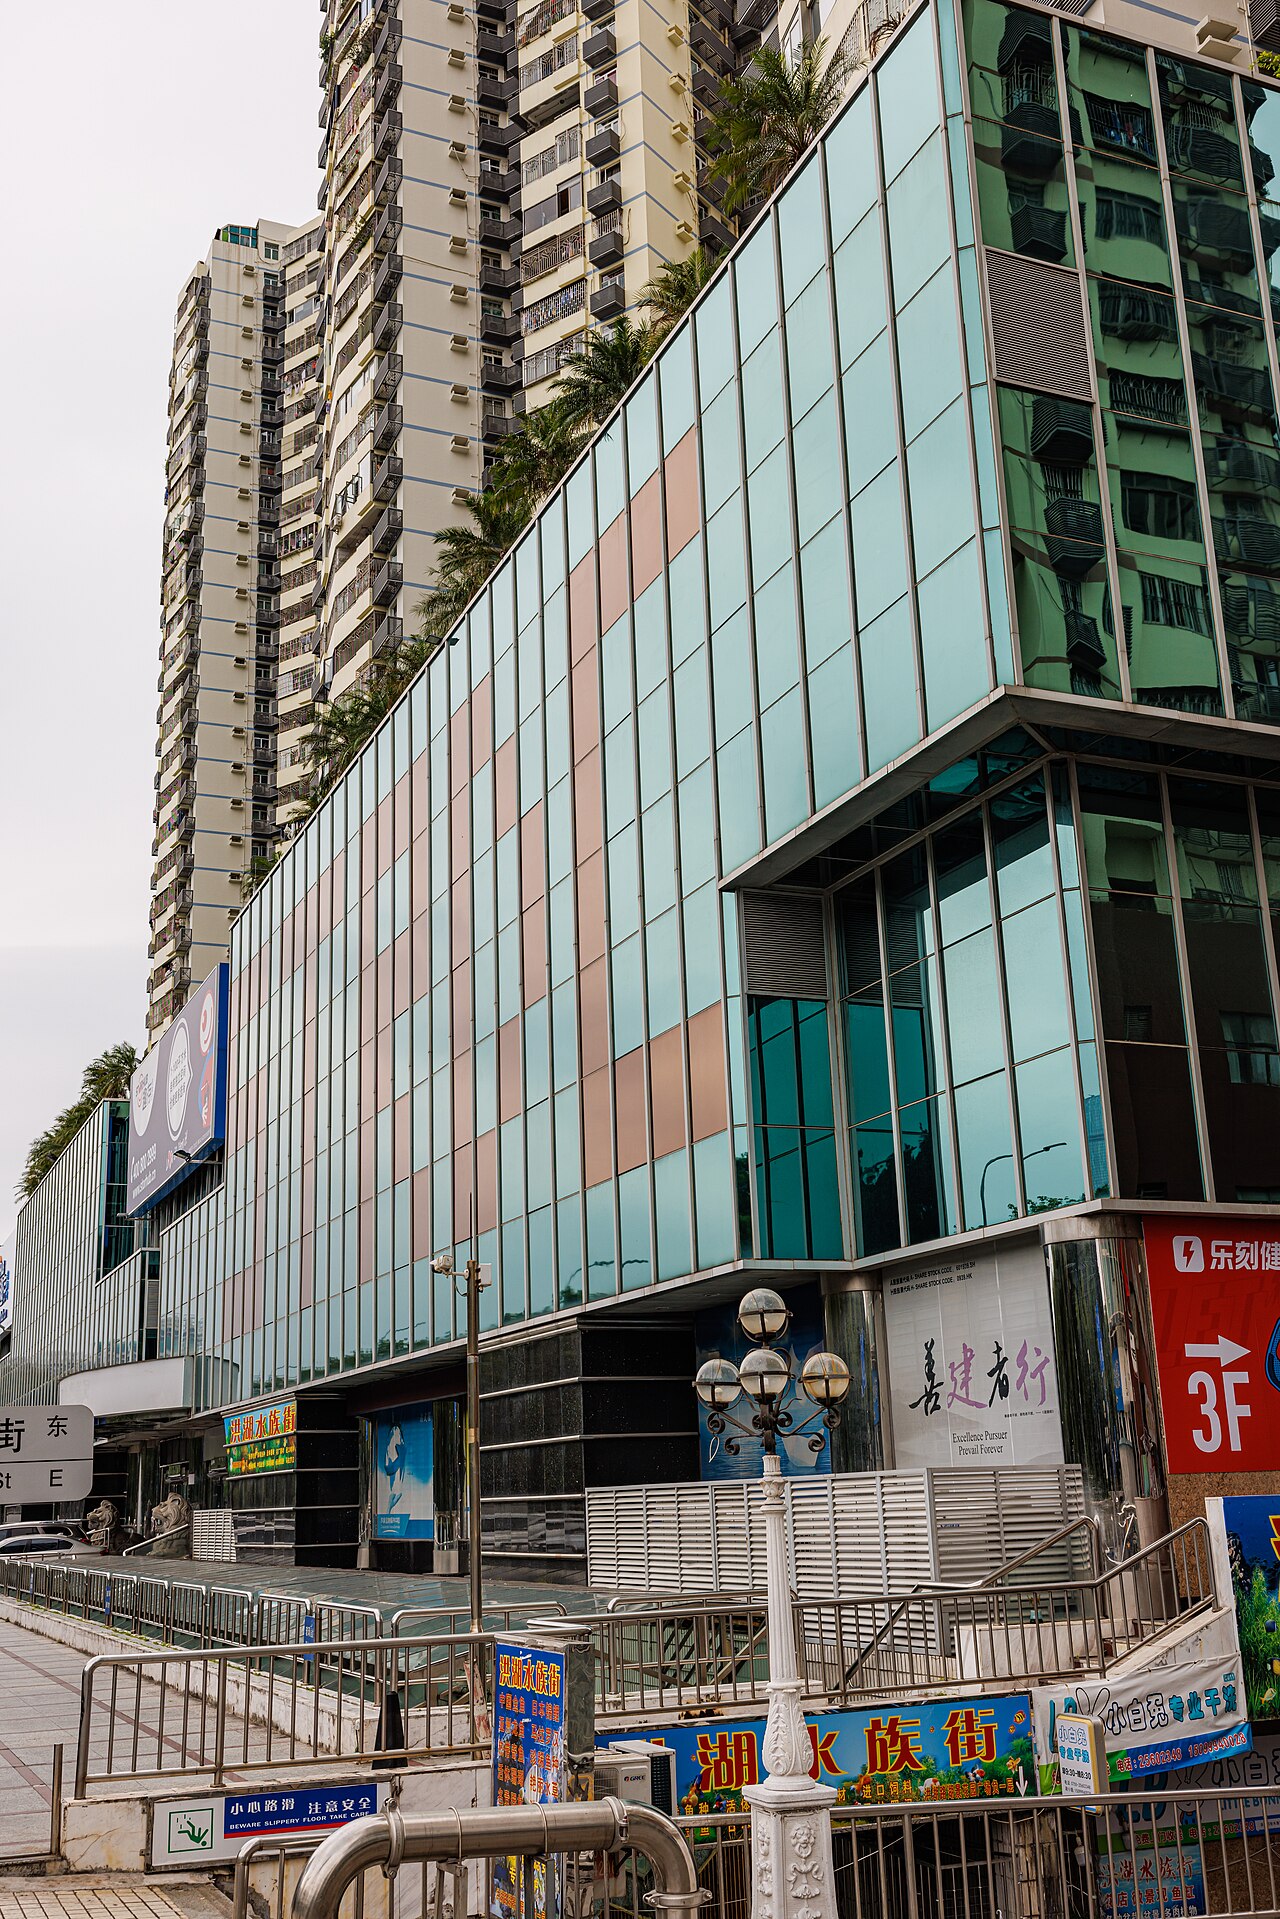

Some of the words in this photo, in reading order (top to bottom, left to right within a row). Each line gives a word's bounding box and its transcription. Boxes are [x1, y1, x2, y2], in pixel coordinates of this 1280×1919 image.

[909, 1337, 1050, 1417] 善建者行
[1188, 1371, 1251, 1453] 3F
[47, 1415, 68, 1437] 东
[230, 1404, 296, 1445] 洪湖水族街
[952, 1431, 983, 1443] Excellence
[985, 1430, 1007, 1441] Pursuer
[958, 1444, 979, 1455] Prevail
[980, 1443, 1003, 1454] Forever
[50, 1469, 63, 1487] E
[499, 1653, 561, 1698] 洪湖水族街
[863, 1780, 912, 1799] 进口饲料
[230, 1798, 295, 1815] 小心路滑
[308, 1797, 371, 1815] 注意安全
[229, 1821, 262, 1830] BEWARE
[264, 1818, 300, 1827] SLIPPERY
[302, 1815, 327, 1823] FLOOR
